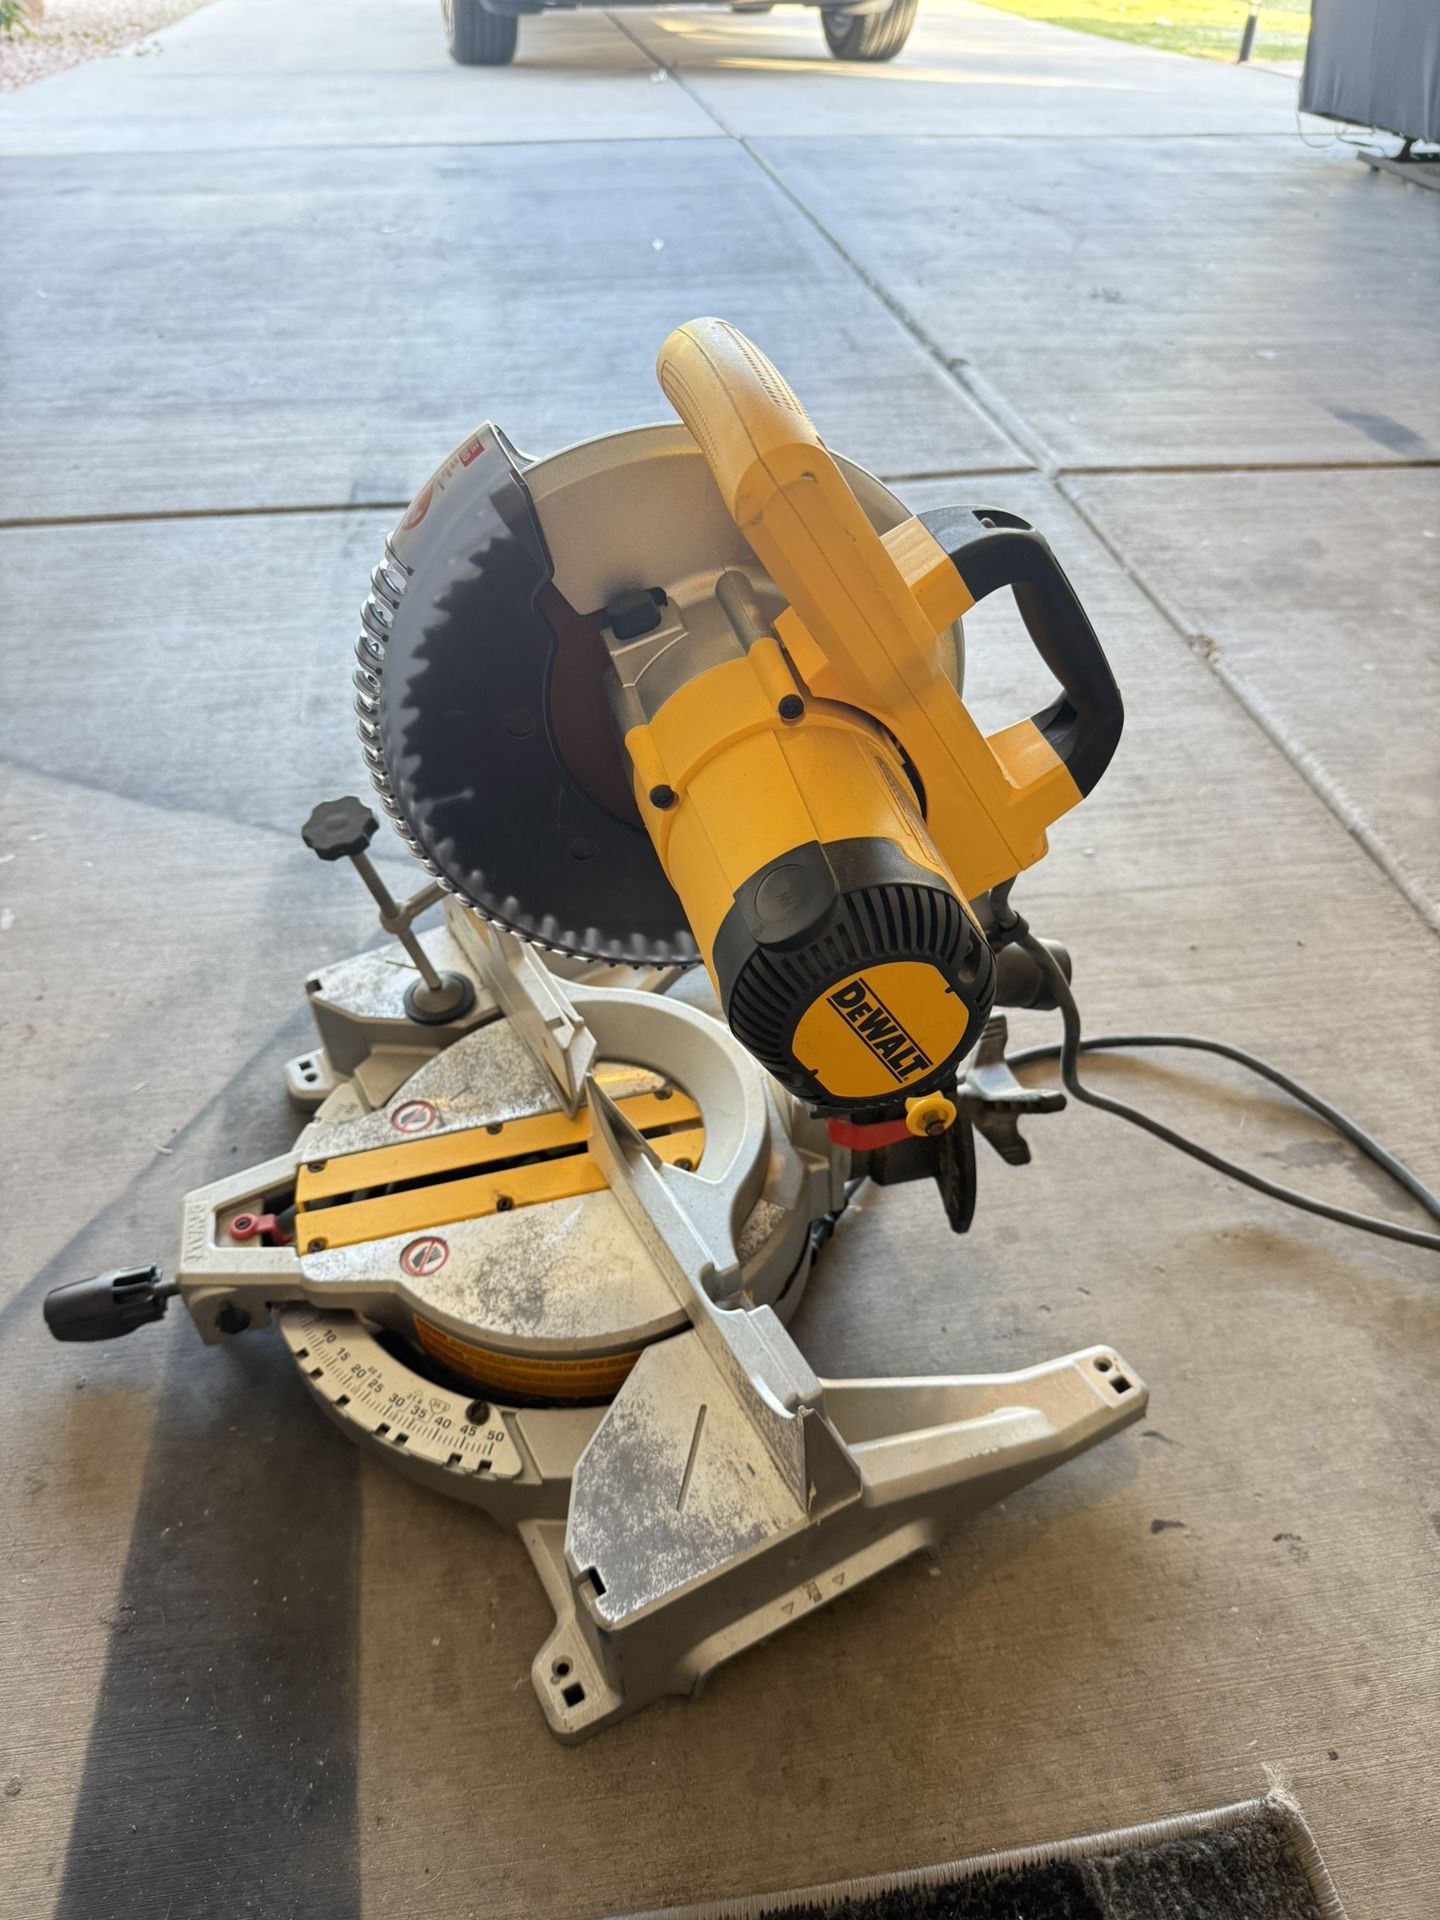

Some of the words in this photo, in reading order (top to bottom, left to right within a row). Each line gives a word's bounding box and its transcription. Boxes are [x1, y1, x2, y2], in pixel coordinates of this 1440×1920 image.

[323, 1329, 337, 1344] 10
[337, 1346, 351, 1361] 15
[350, 1363, 367, 1378] 20
[367, 1378, 384, 1393] 25
[388, 1392, 406, 1407] 30
[410, 1404, 428, 1419] 35
[434, 1416, 452, 1429] 40
[460, 1424, 477, 1437] 45
[487, 1430, 505, 1442] 50
